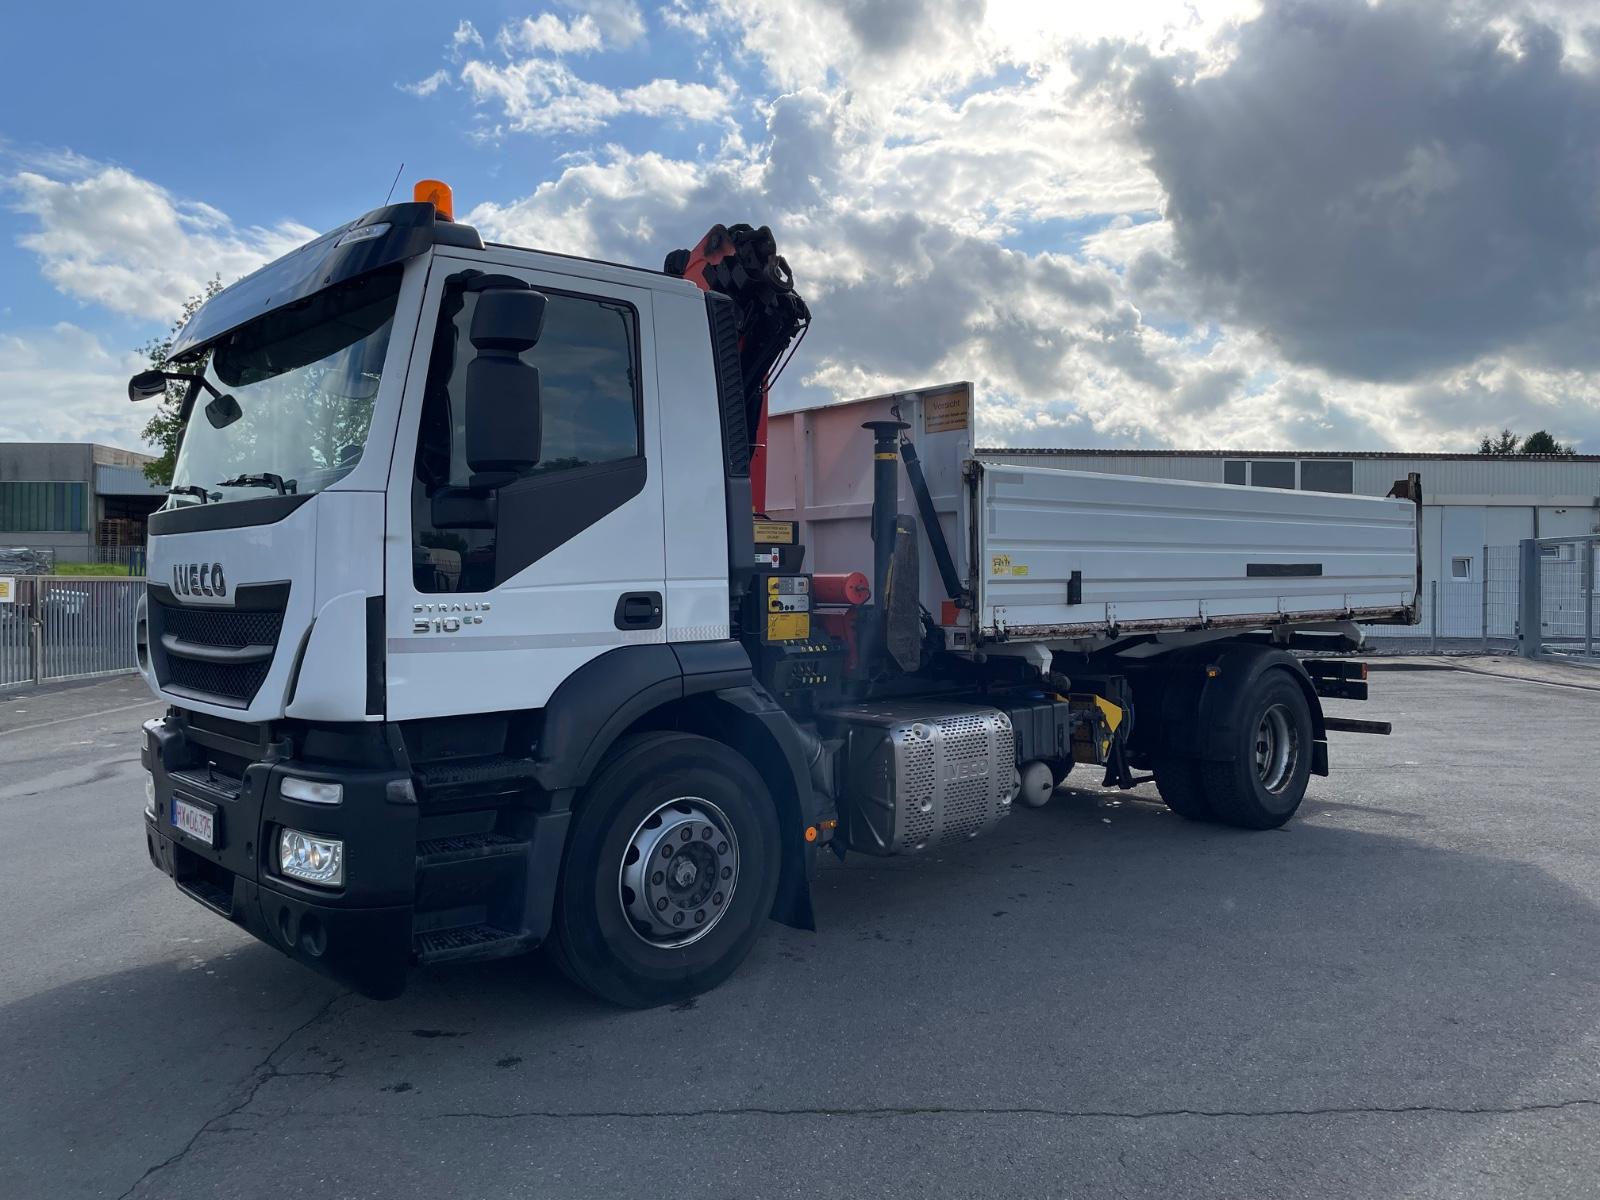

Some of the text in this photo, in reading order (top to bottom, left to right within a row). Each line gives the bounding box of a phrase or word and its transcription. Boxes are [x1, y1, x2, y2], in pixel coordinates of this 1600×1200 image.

[173, 562, 226, 597] IVECO
[413, 602, 491, 613] STRALIS
[413, 616, 460, 634] 310
[943, 759, 989, 781] IVECO
